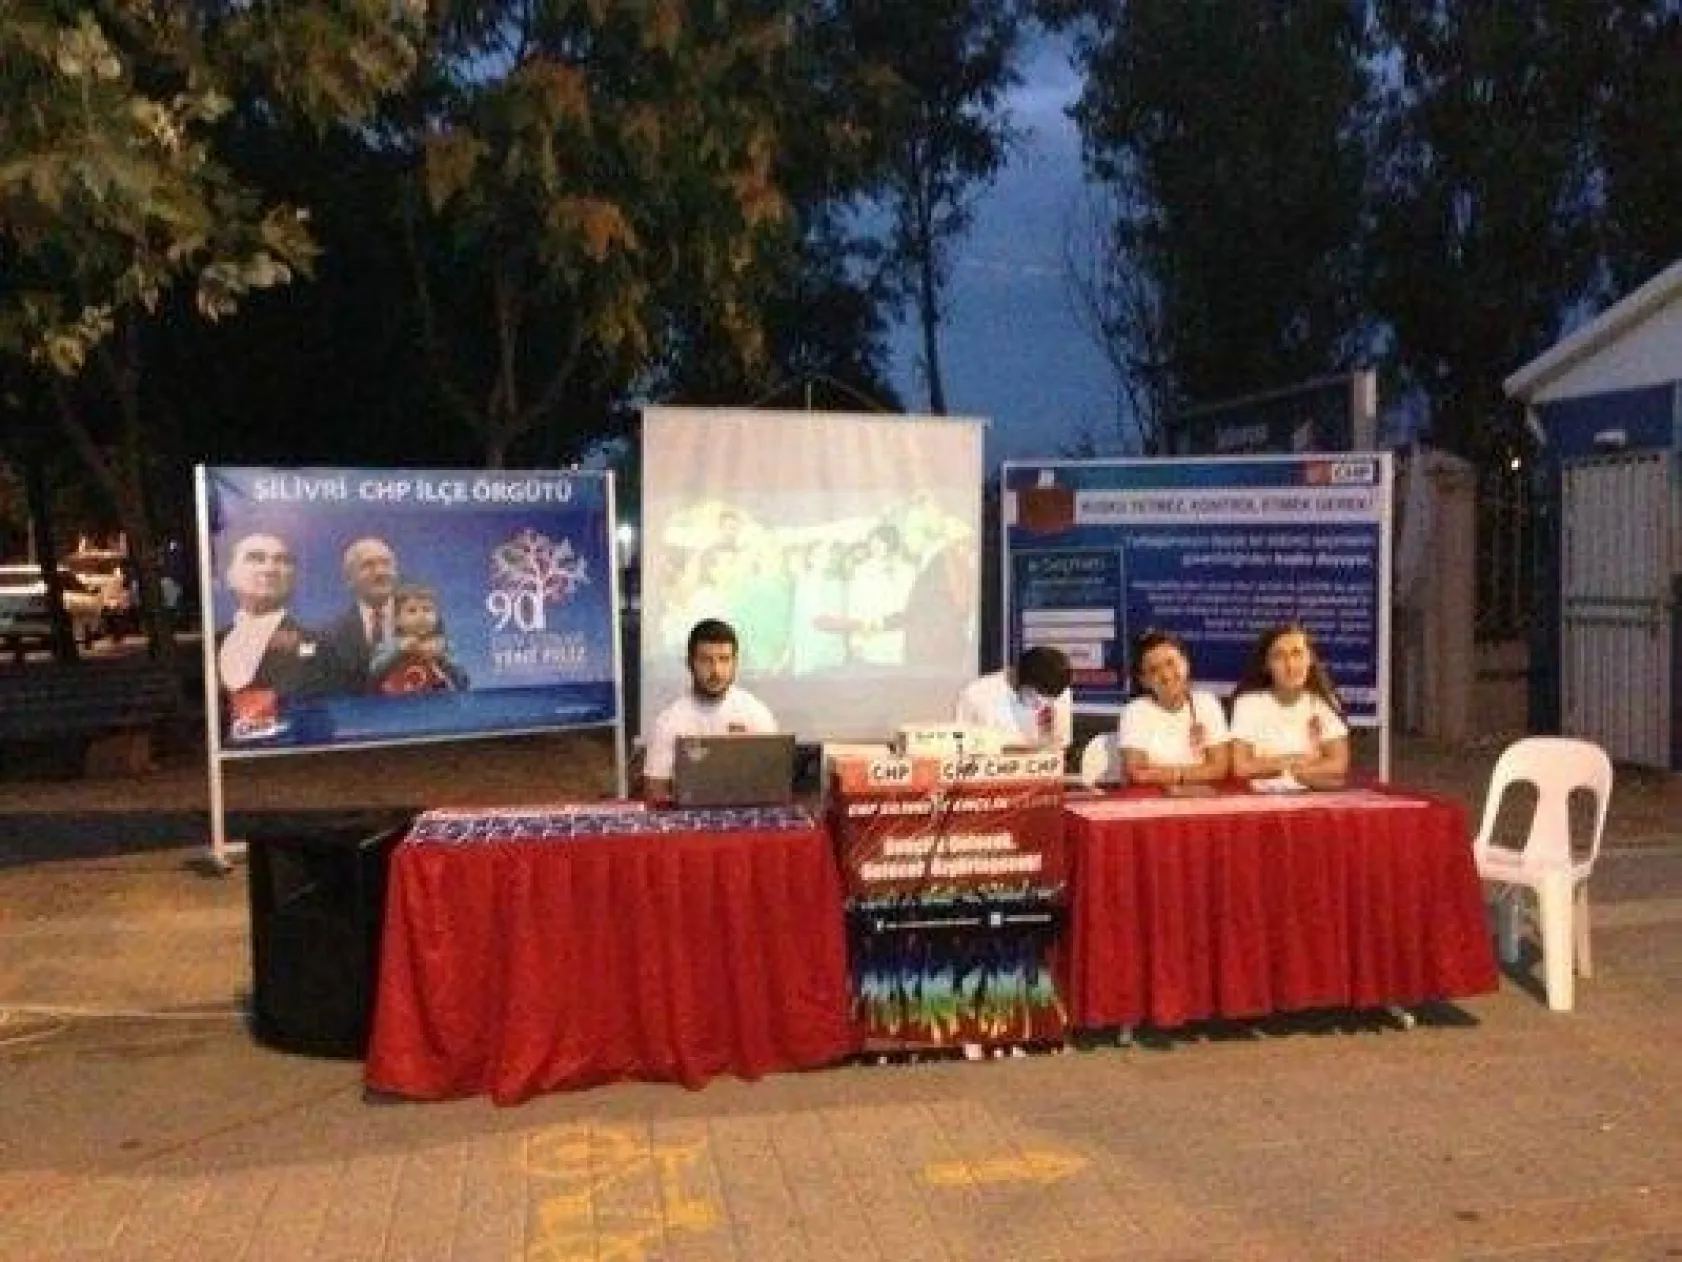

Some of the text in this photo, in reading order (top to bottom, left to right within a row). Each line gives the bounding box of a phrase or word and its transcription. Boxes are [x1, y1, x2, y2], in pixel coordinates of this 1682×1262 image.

[253, 477, 346, 502] SİLİVRİ
[359, 479, 410, 502] CHP
[416, 476, 468, 505] İLÇE
[486, 590, 546, 632] 90
[872, 763, 910, 780] CHP
[985, 760, 1019, 777] CHP
[1026, 757, 1060, 774] CHP
